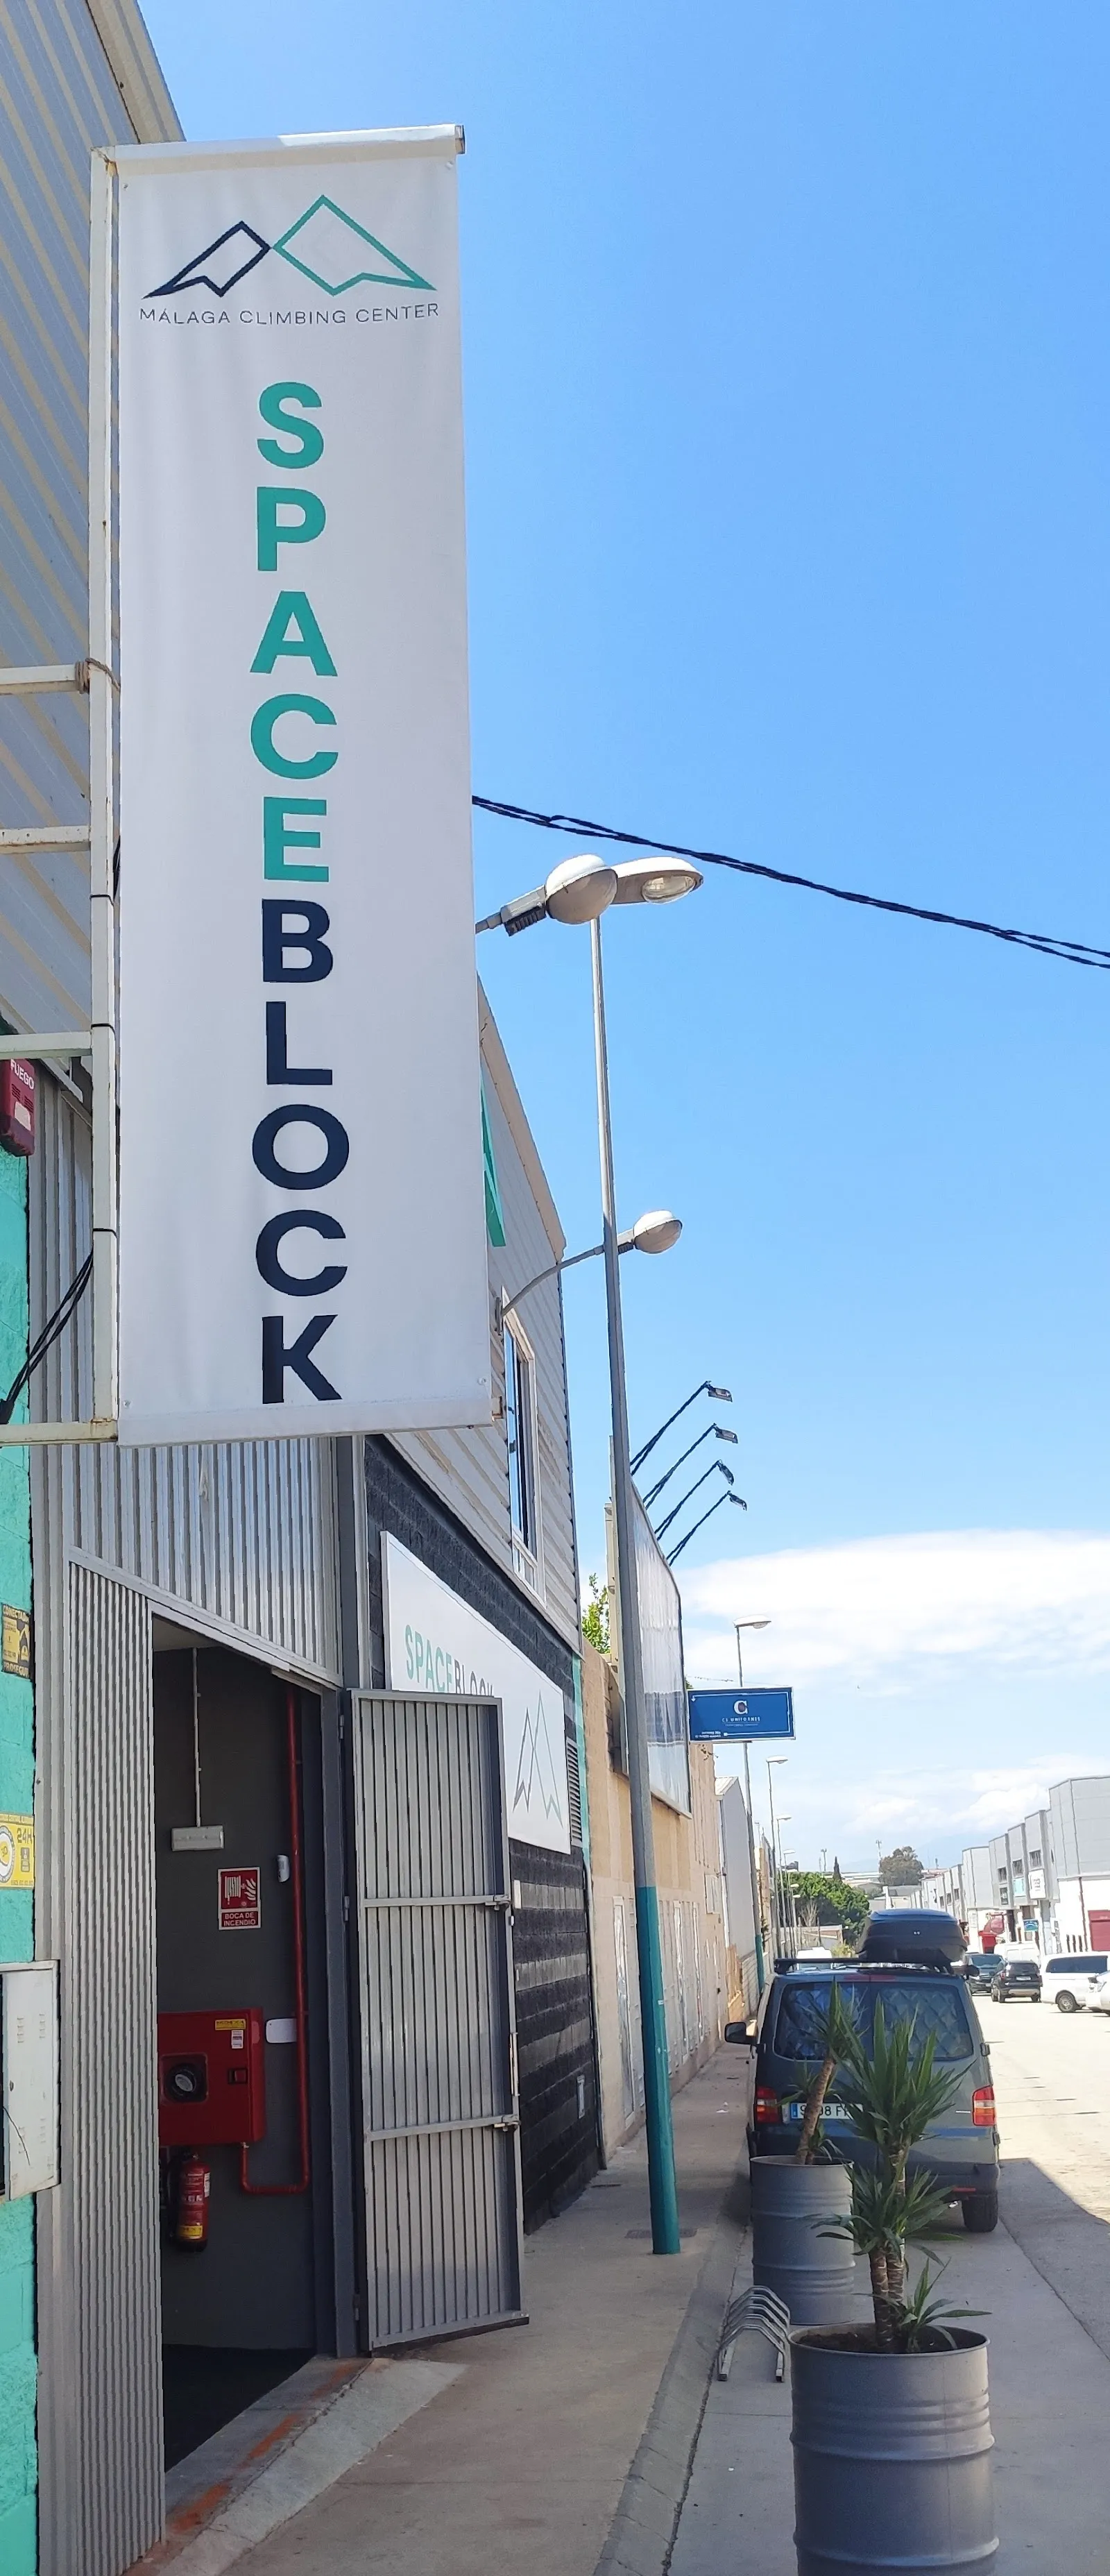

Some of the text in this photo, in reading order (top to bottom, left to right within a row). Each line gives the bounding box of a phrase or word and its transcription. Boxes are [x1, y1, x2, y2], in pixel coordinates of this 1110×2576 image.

[140, 303, 438, 325] MÁLAGA CLIMBING CENTER
[10, 1059, 35, 1090] FUEGO
[17, 1828, 33, 1844] 24H
